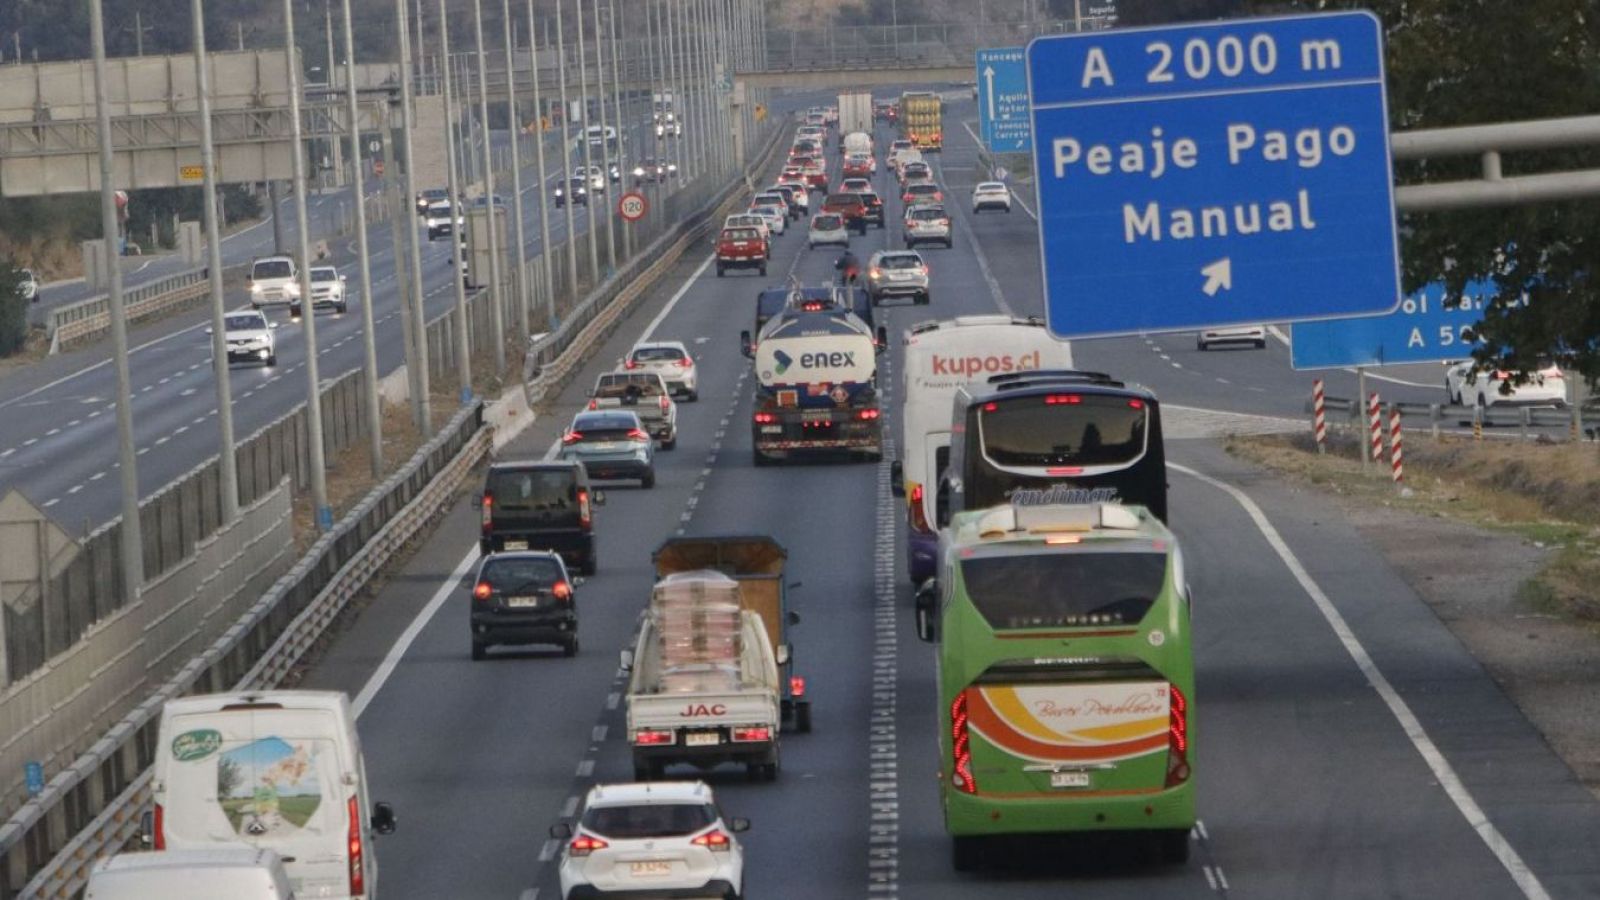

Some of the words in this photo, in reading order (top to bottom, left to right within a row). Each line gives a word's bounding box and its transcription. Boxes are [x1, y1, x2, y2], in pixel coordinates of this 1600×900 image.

[1082, 48, 1114, 88] A
[1146, 34, 1277, 83] 2000
[1301, 39, 1340, 70] m
[1053, 127, 1197, 178] Peaje
[1227, 124, 1355, 168] Pago
[624, 201, 641, 213] 120
[1123, 189, 1315, 243] Manual
[1408, 327, 1425, 347] A
[800, 351, 855, 369] enex
[932, 351, 1041, 377] kupos.cl
[680, 704, 727, 717] JAC
